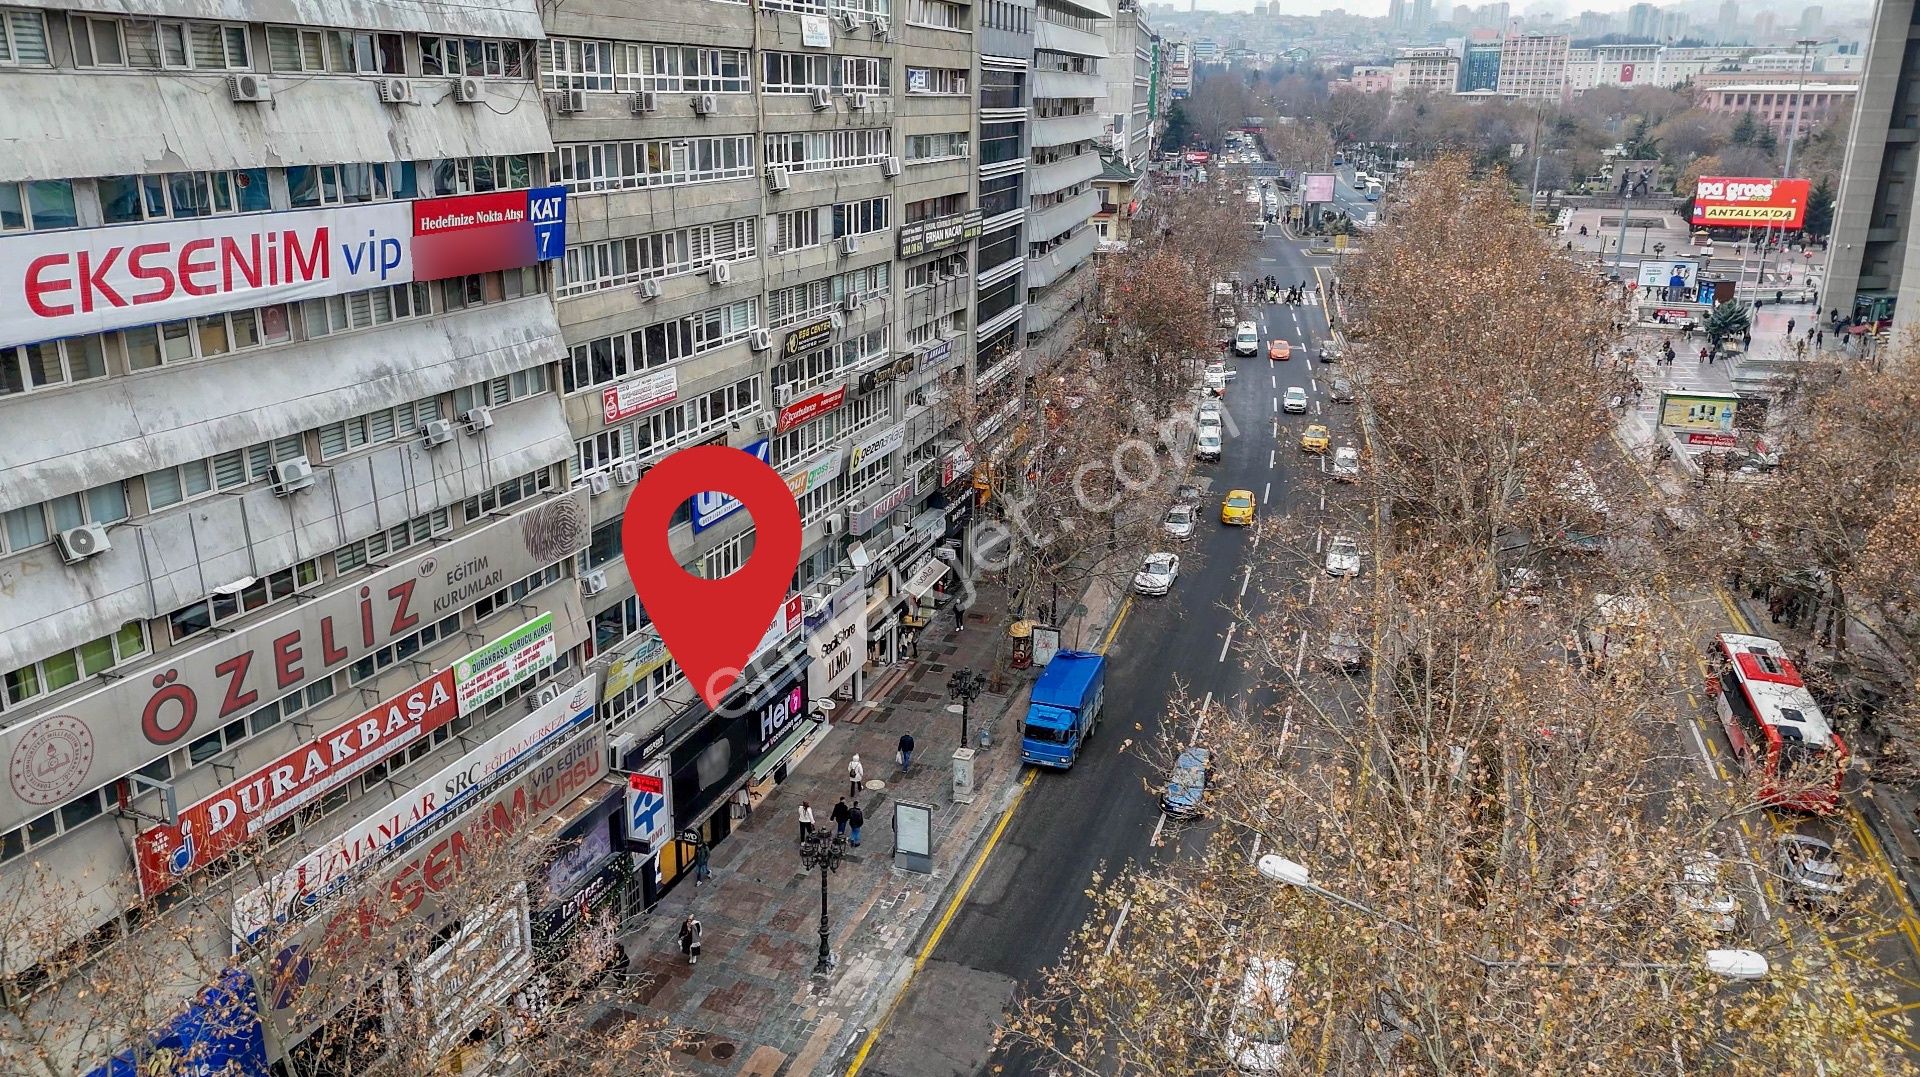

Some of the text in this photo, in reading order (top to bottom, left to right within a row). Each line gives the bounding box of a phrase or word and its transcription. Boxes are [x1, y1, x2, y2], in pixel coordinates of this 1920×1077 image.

[1725, 183, 1773, 201] gross
[421, 207, 523, 231] Hedefinize Nokta Atışı
[531, 198, 562, 218] KAT
[1708, 209, 1792, 218] ANTALYA'DA
[342, 229, 402, 281] vip
[542, 232, 550, 254] 7
[447, 556, 488, 585] EĞİTİM
[433, 569, 502, 613] KURUMLARI
[207, 681, 451, 836] DURAKBAŞA
[484, 744, 521, 776] EĞİTİM
[532, 766, 555, 788] vip
[533, 750, 600, 812] KURSU
[296, 792, 437, 894] UZMANLAR
[445, 761, 481, 802] SRC
